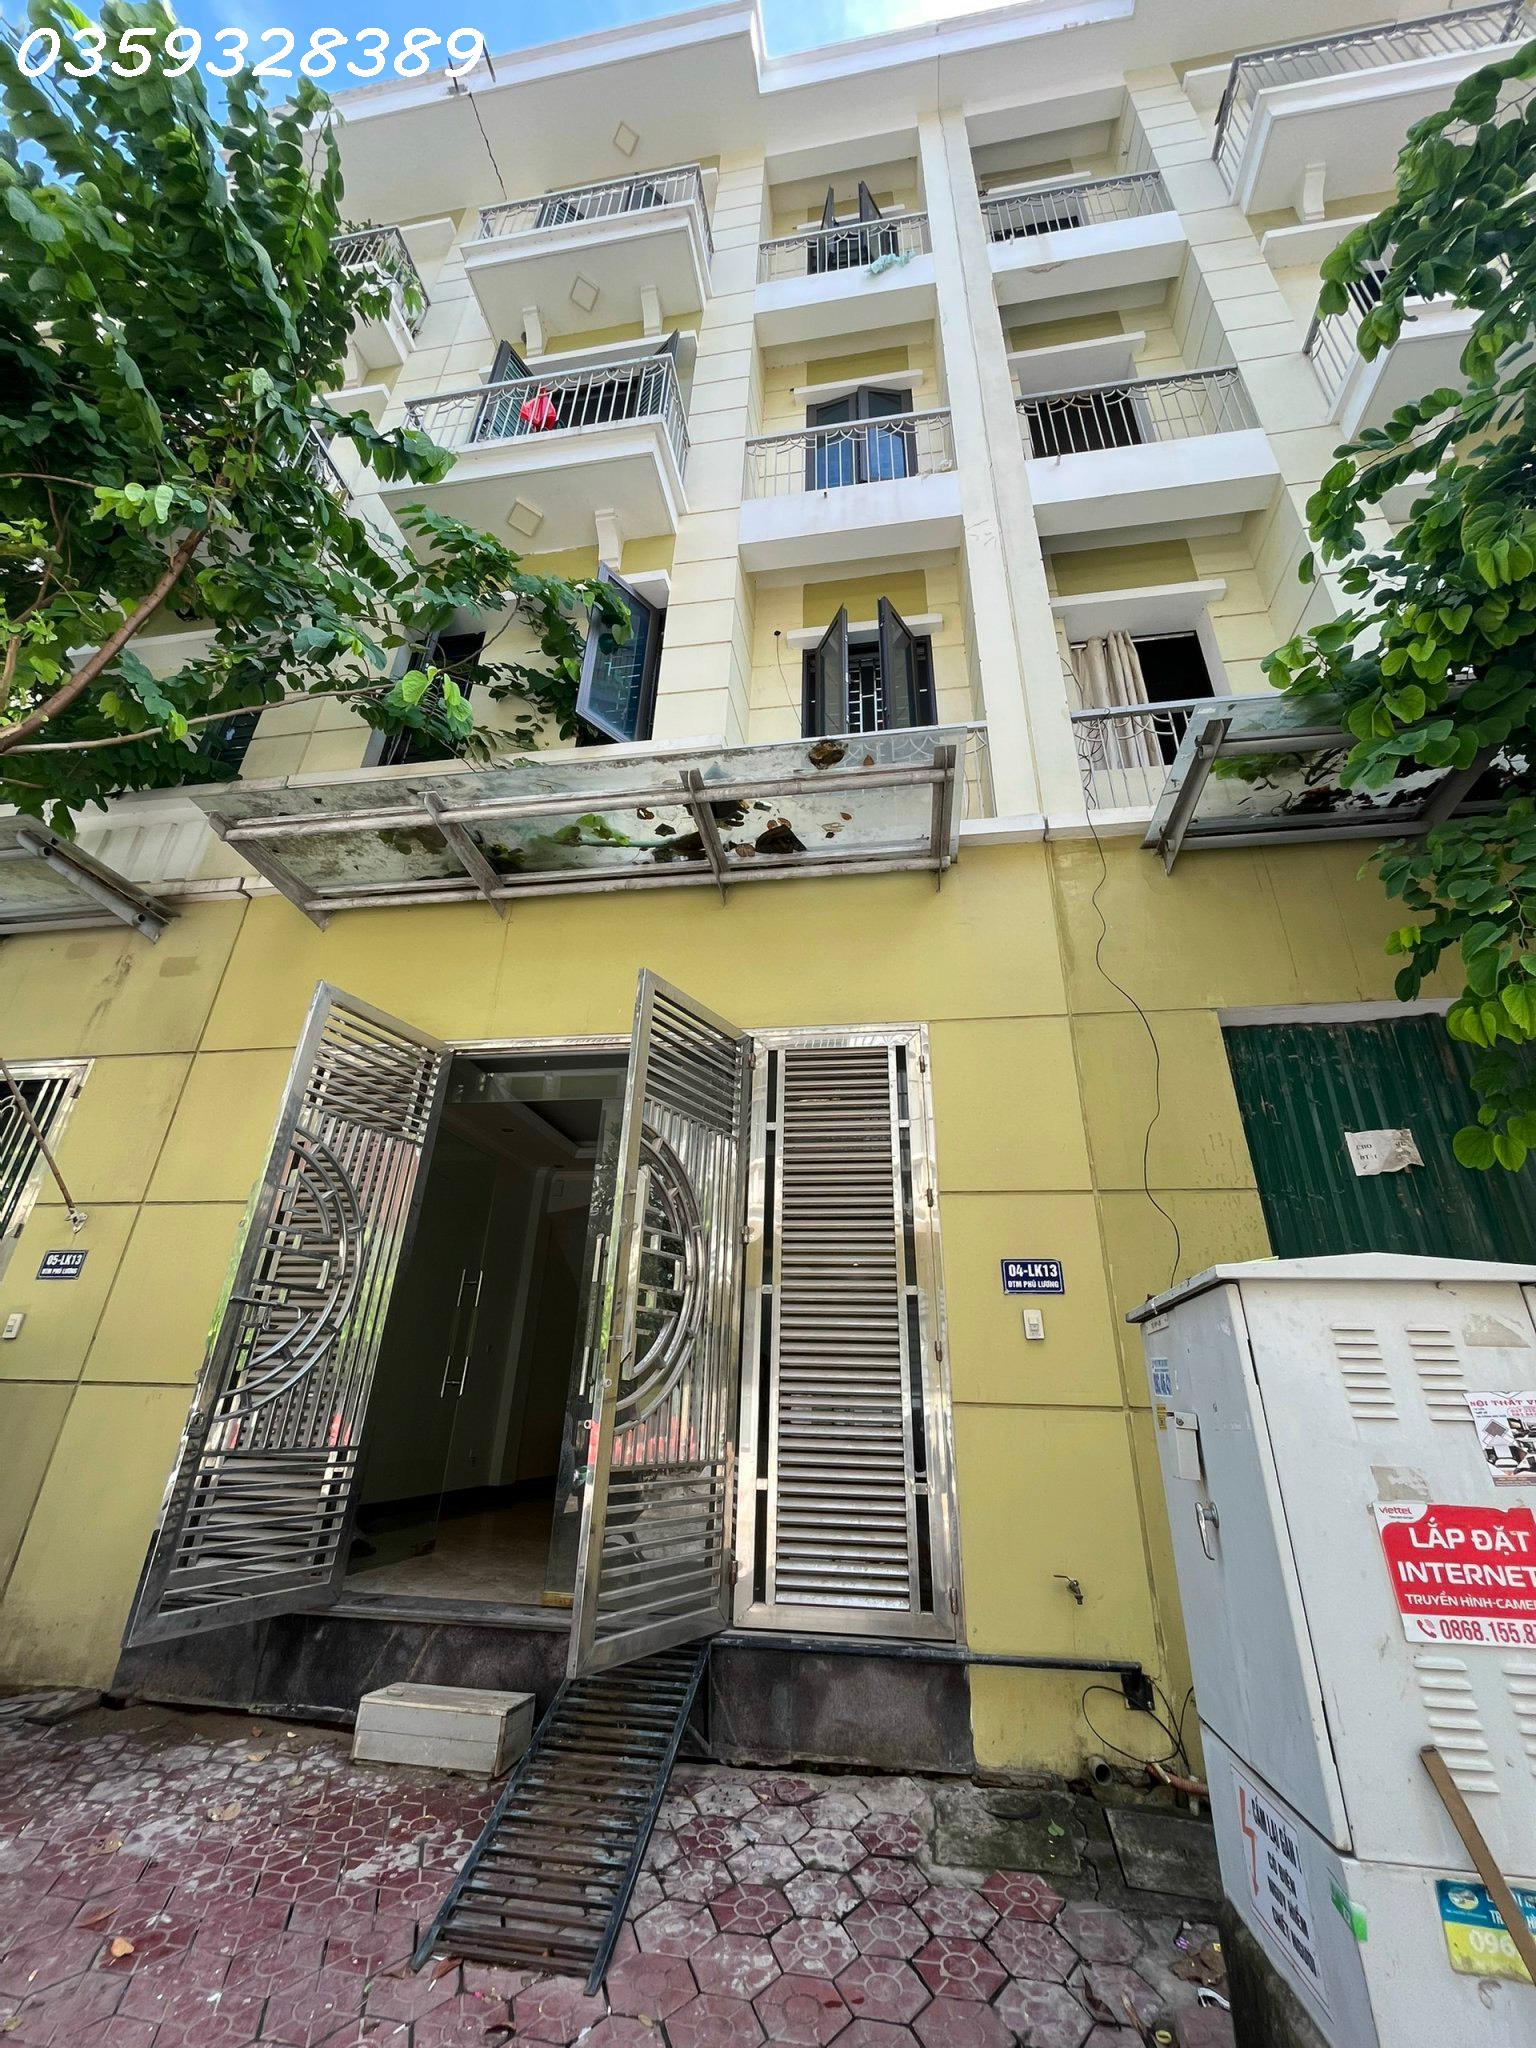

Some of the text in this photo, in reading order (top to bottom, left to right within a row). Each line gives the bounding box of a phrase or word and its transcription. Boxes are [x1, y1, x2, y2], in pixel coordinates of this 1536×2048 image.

[46, 1254, 83, 1265] 05-LK13
[1008, 1264, 1058, 1277] 04-LK13
[1378, 1506, 1413, 1515] viettel
[1408, 1516, 1531, 1556] LẮP ĐẶT
[1397, 1560, 1536, 1588] INTERNET
[1404, 1590, 1458, 1606] TRUYỀN
[1440, 1619, 1536, 1645] 0868.155.8
